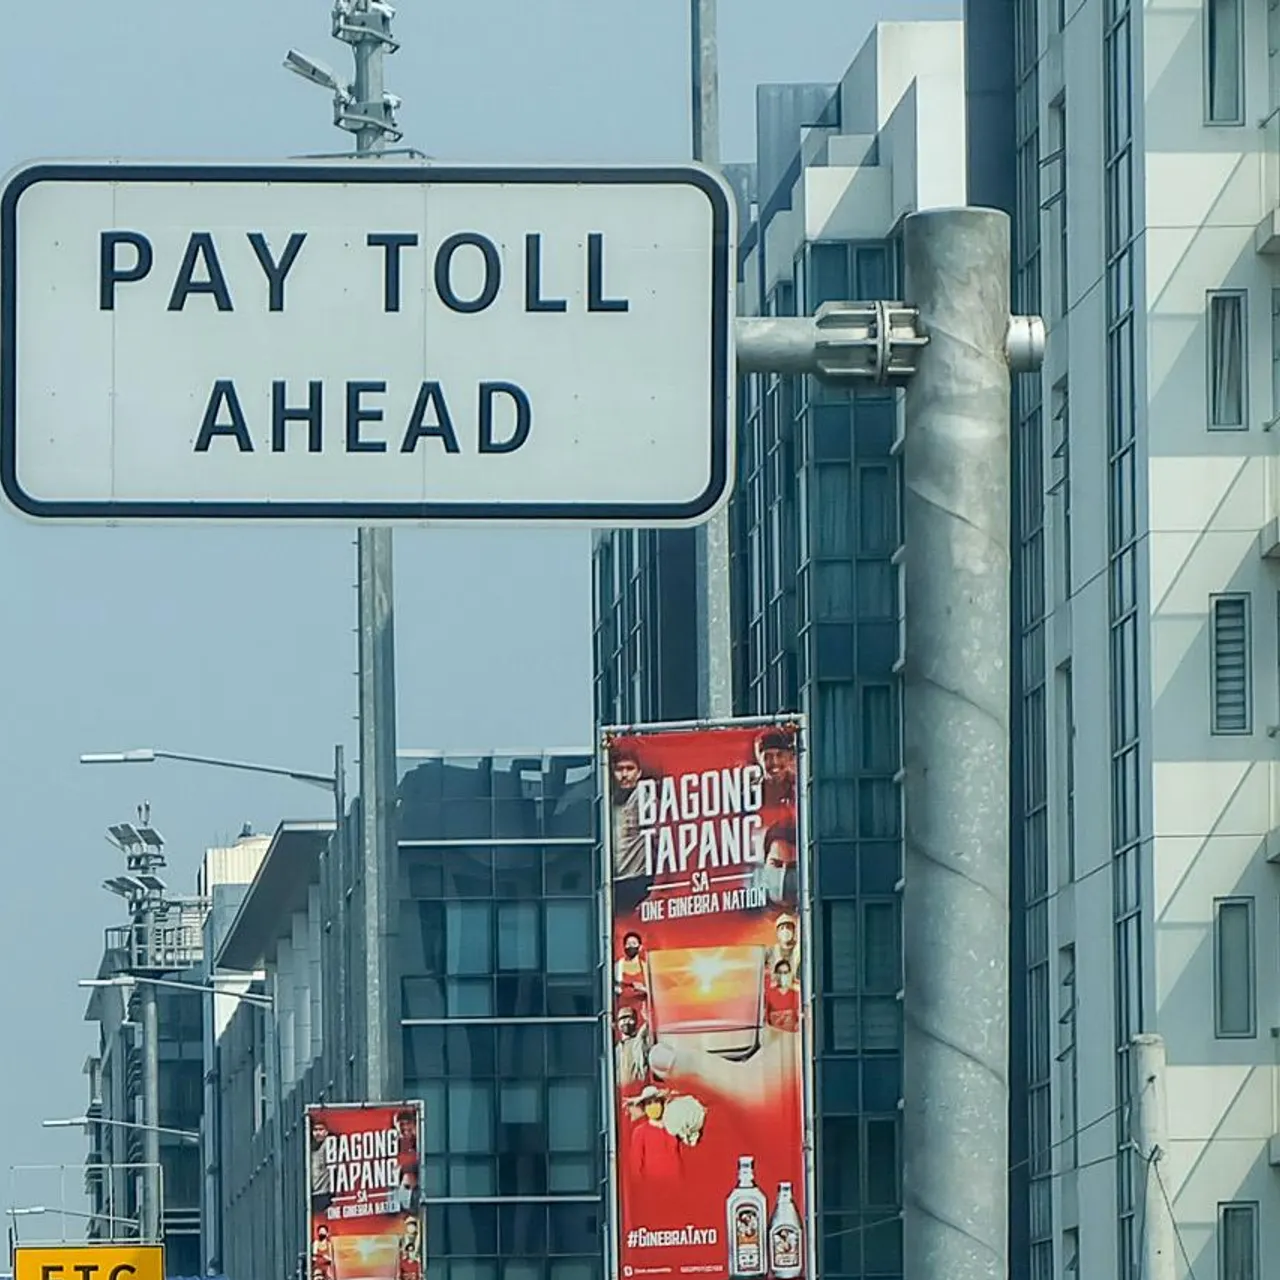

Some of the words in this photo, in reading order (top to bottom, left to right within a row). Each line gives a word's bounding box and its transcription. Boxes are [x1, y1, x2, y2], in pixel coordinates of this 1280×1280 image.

[98, 231, 308, 313] PAY
[366, 231, 630, 314] TOLL
[193, 380, 533, 454] AHEAD
[639, 764, 765, 827] BAGONG
[640, 814, 766, 877] TAPANG
[641, 900, 664, 922] ONE
[668, 894, 720, 919] GINEBRA
[723, 887, 767, 912] NATION
[691, 871, 711, 893] SA
[325, 1129, 399, 1164] BAGONG
[327, 1158, 400, 1193] TAPANG
